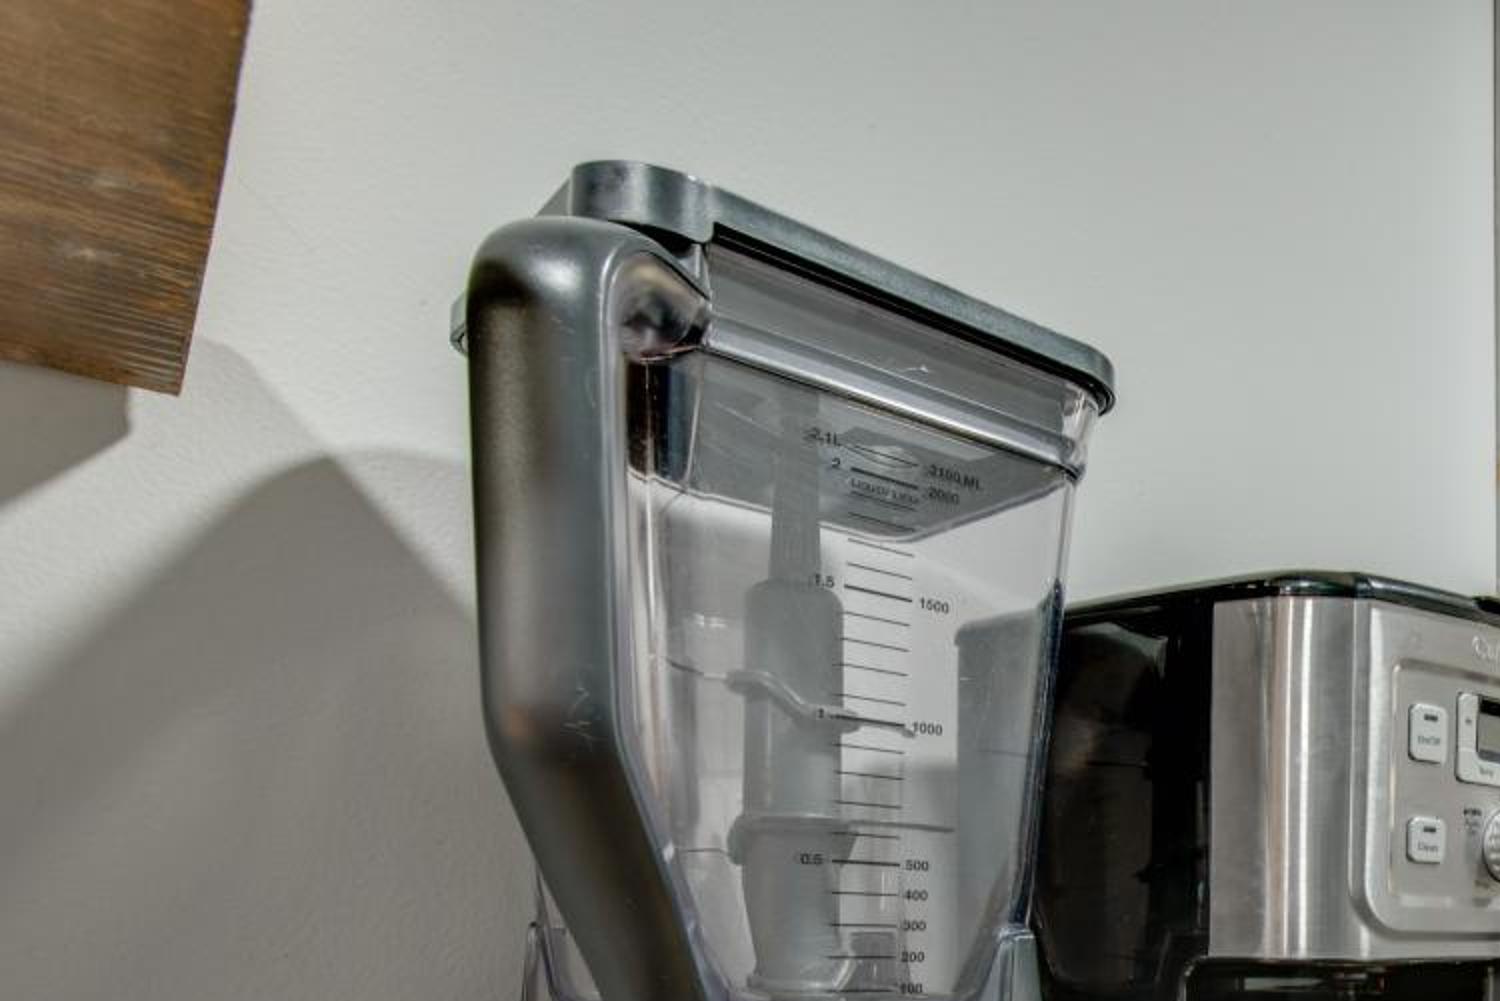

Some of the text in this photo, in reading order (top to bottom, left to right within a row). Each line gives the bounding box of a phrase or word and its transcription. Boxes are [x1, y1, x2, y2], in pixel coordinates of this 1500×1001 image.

[831, 456, 841, 469] 2
[813, 574, 835, 588] 1.5
[919, 598, 949, 614] 1500
[912, 721, 943, 737] 1000
[800, 853, 823, 866] 0.5
[906, 859, 929, 872] 500
[904, 889, 928, 902] 400
[902, 919, 926, 932] 300
[901, 950, 925, 963] 200
[900, 982, 923, 995] 100
